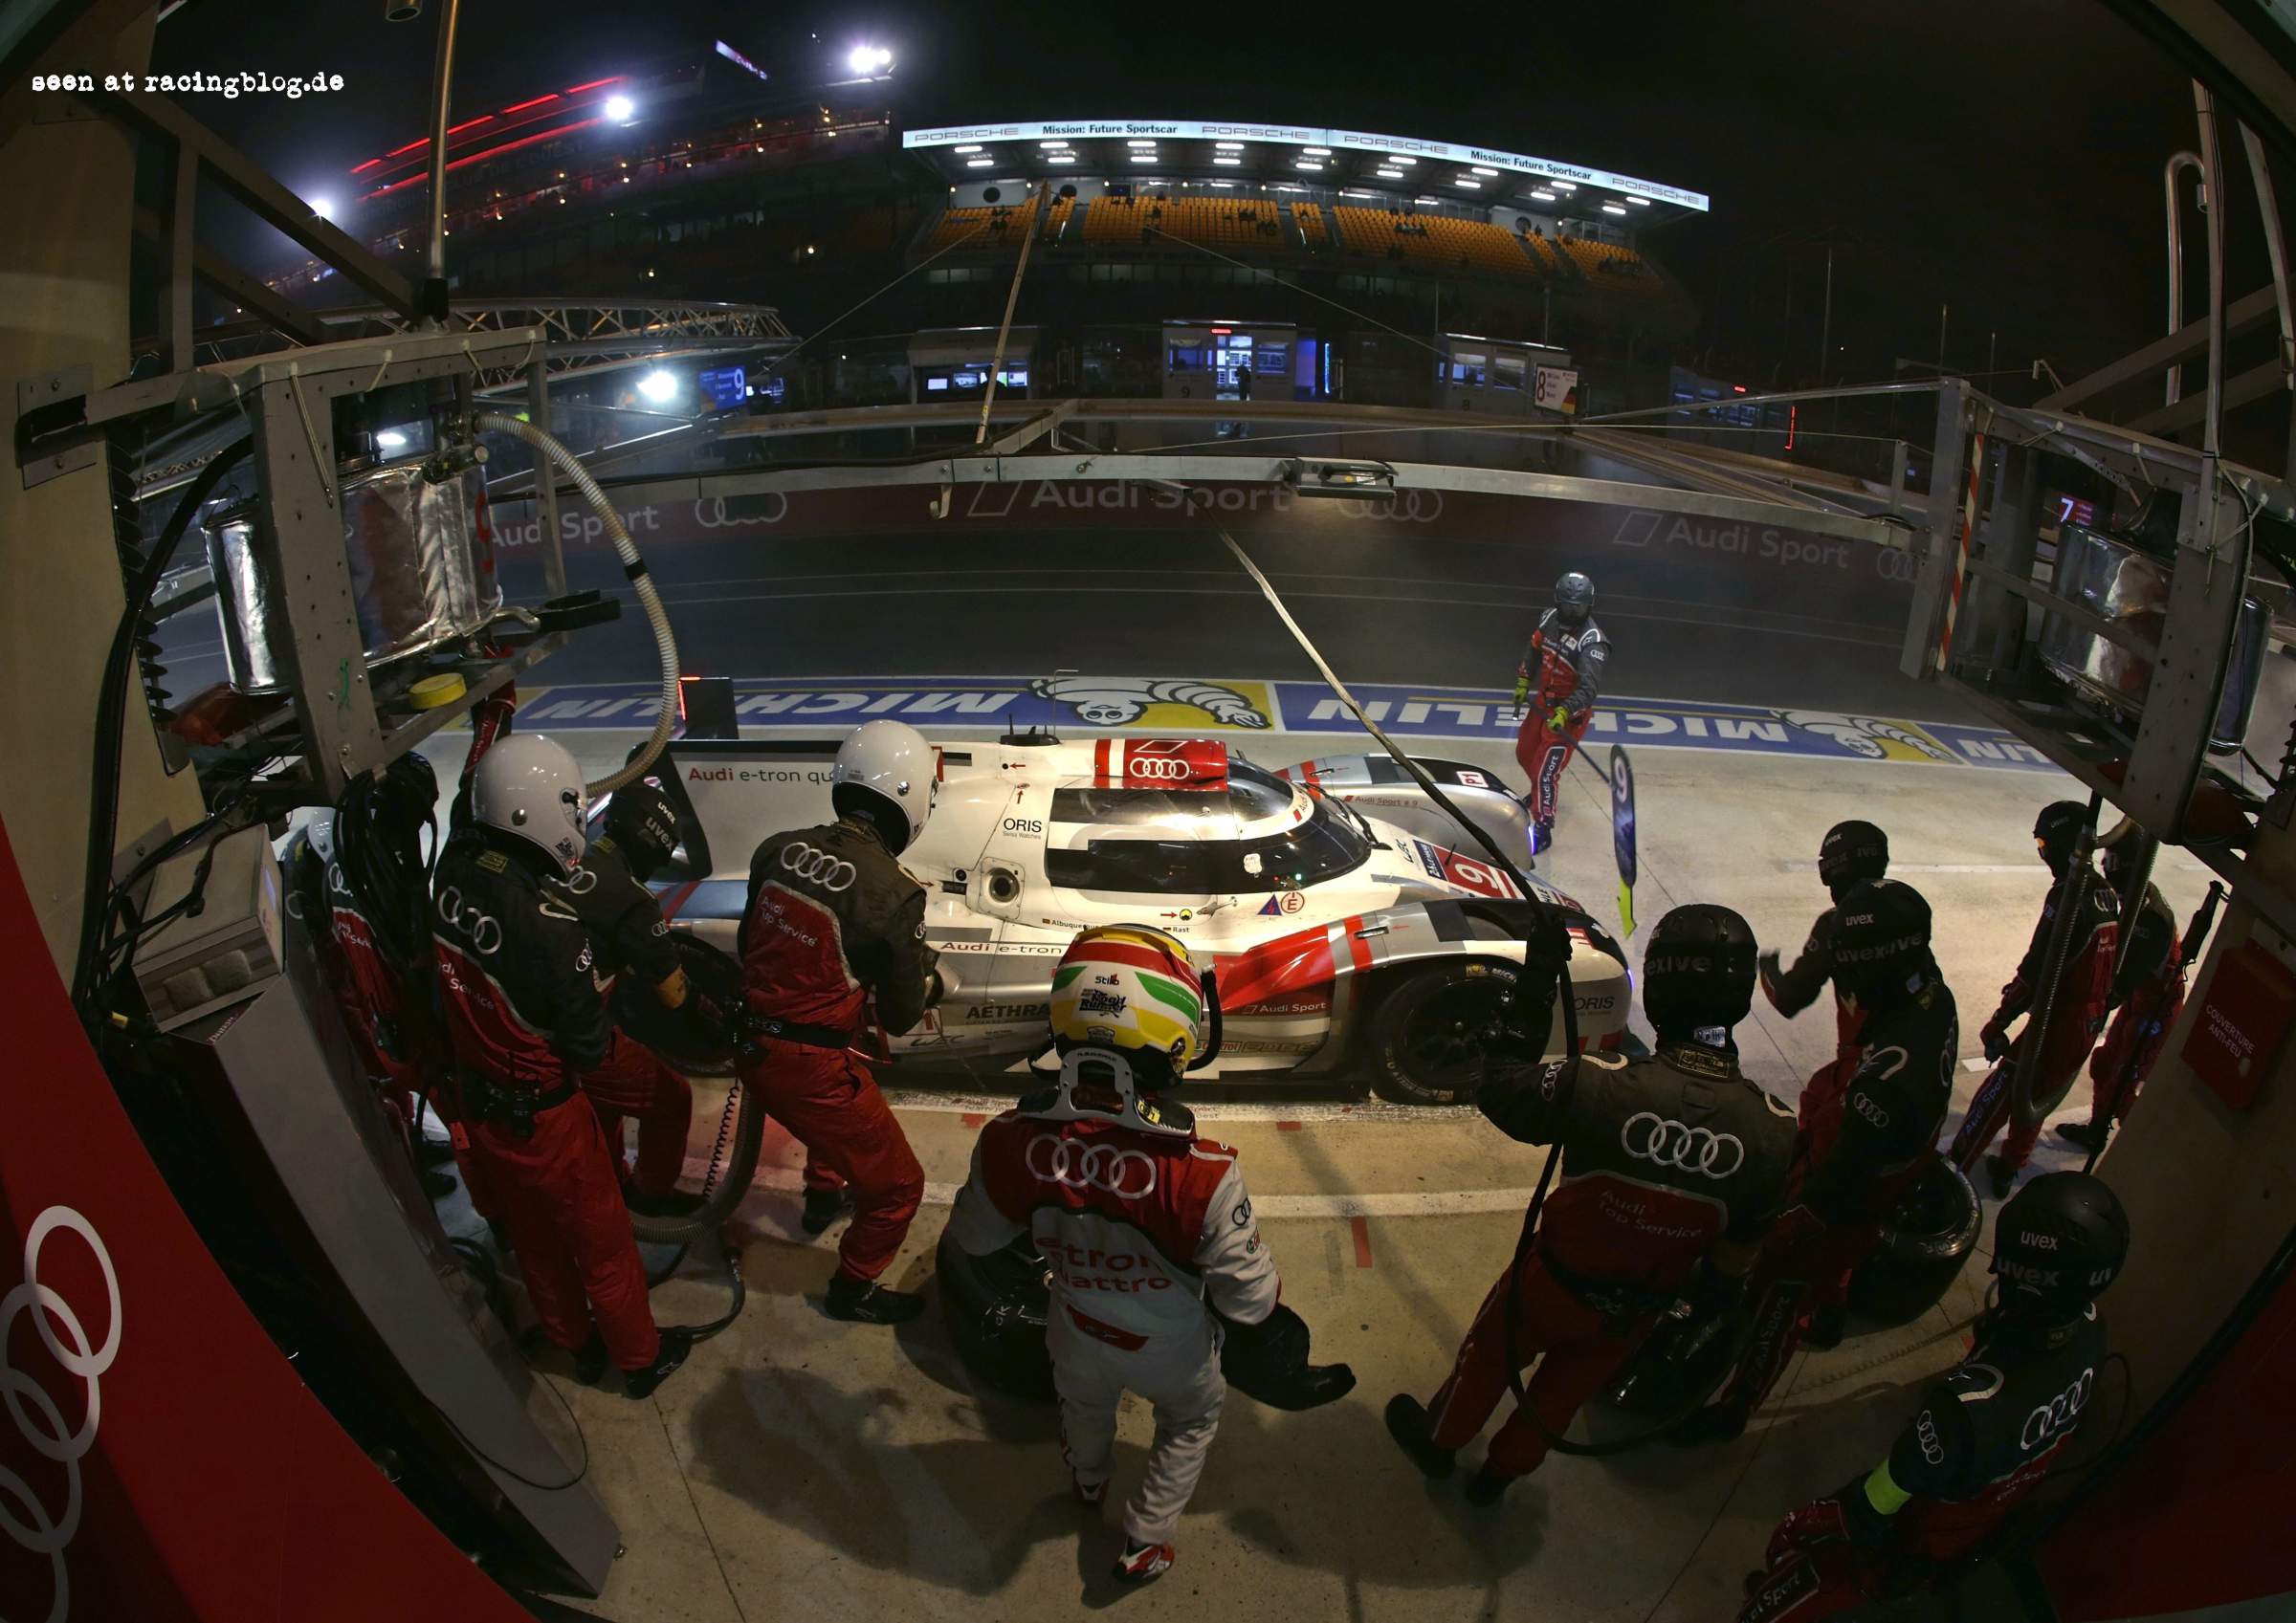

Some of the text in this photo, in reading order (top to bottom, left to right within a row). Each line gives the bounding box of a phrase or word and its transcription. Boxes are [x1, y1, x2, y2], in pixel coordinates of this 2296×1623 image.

[916, 128, 1018, 142] PORSCHE
[1043, 123, 1178, 136] Mission: Future Sportscar
[1203, 126, 1309, 139] PORSCHE
[1345, 136, 1447, 154] PORSCHE
[1471, 150, 1592, 181] Mission: Future Sportscar
[1612, 177, 1699, 205] PORSCHE
[734, 368, 744, 400] 9
[1537, 370, 1546, 402] 8
[1031, 479, 1292, 515] Audi Sport
[2060, 497, 2074, 522] 7
[491, 505, 661, 547] Aud Sprt
[1667, 522, 1850, 569] Audi Sport
[527, 691, 1020, 719] MICHLIN
[689, 768, 733, 781] Audi
[740, 770, 801, 782] e-tron
[1462, 771, 1486, 786] P1
[1614, 755, 1627, 804] 9
[1378, 797, 1401, 805] Sport
[1004, 818, 1042, 832] ORIS
[1454, 863, 1499, 890] 9
[1173, 926, 1190, 934] Rast
[1845, 912, 1875, 927] uvex
[940, 942, 1063, 954] Audi e-tron
[1094, 974, 1120, 986] Stilo
[1259, 1002, 1327, 1014] Audi Sport
[2206, 1004, 2257, 1055] COUVERTURE
[2020, 1230, 2059, 1252] uvex
[1997, 1256, 2060, 1286] uvex
